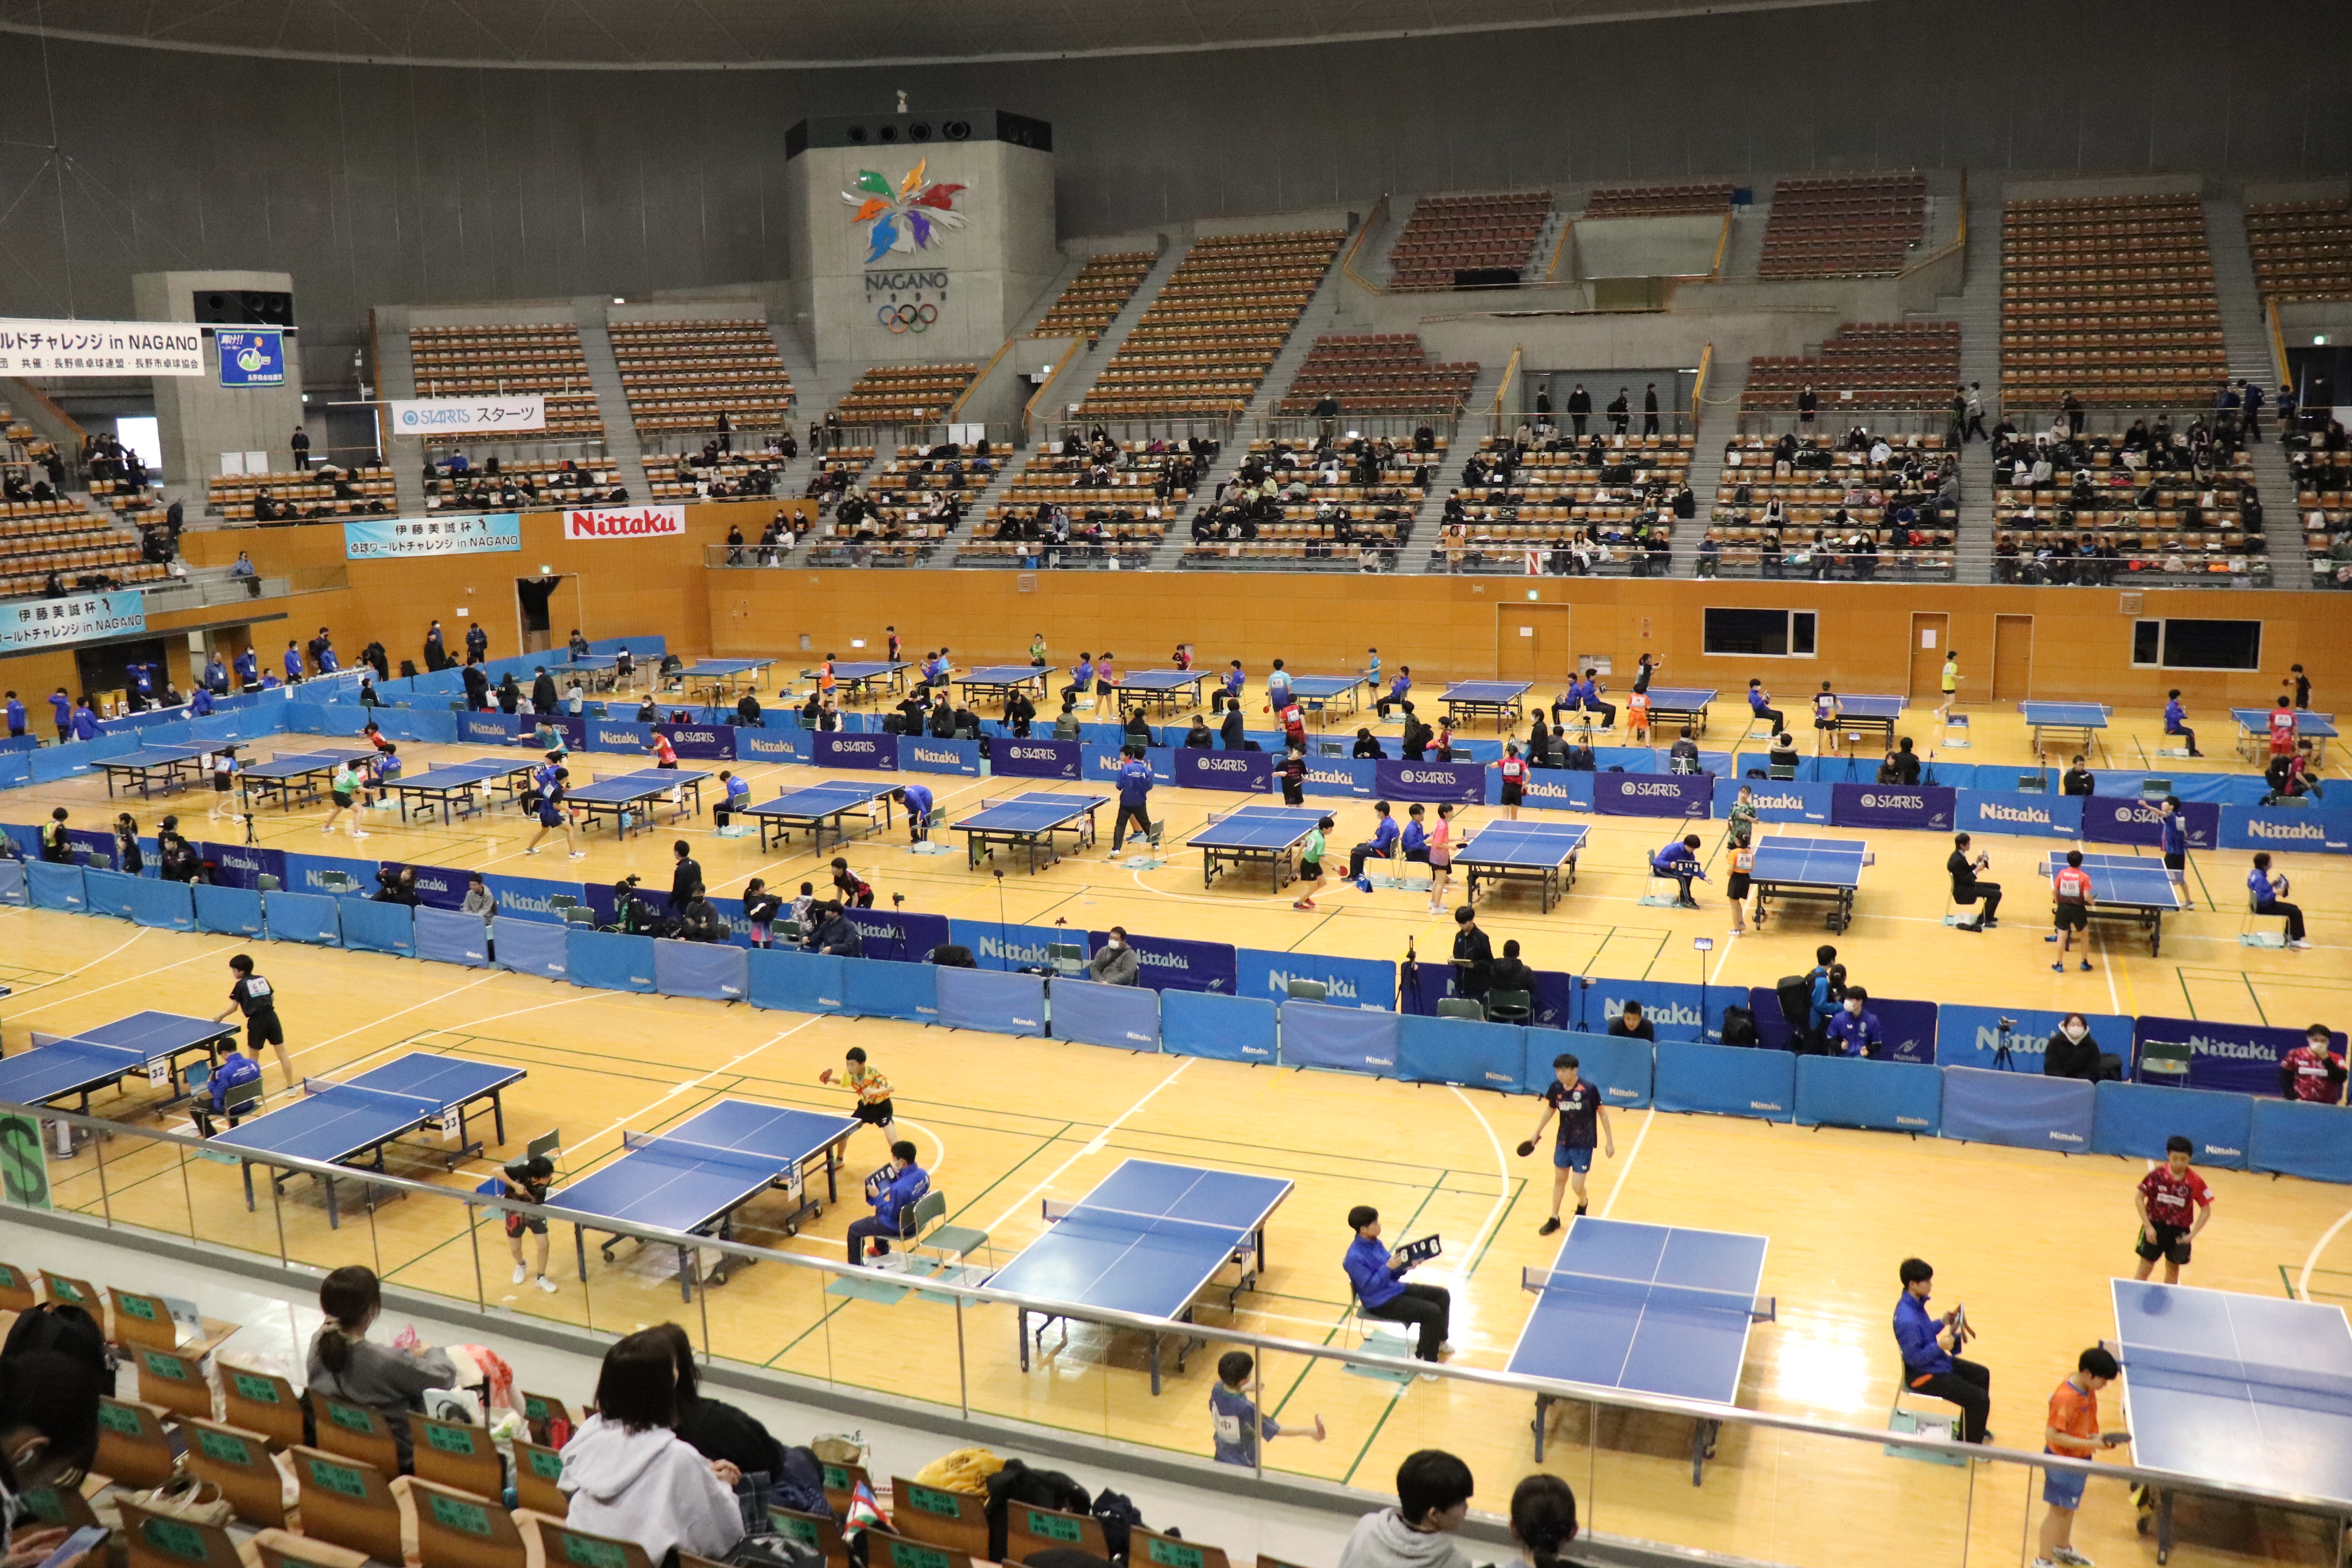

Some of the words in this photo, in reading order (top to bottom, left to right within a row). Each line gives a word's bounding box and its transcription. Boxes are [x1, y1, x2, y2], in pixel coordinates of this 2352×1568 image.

[865, 272, 948, 291] NAGANO
[109, 334, 123, 349] in
[129, 334, 198, 351] NAGANO
[420, 409, 471, 425] STARTS
[477, 407, 534, 423] スターツ
[396, 521, 472, 536] 伊藤美誠杯
[572, 509, 677, 537] Nittaku
[351, 538, 453, 554] 卓球ワールドチャレンジ
[457, 538, 466, 548] in
[470, 535, 518, 547] NAGANO
[1525, 552, 1542, 575] N
[19, 601, 96, 623] 伊藤美誠杯
[0, 622, 80, 643] ールドチャレンジ
[83, 623, 93, 633] in
[96, 615, 142, 631] NAGANO
[469, 721, 506, 736] Nittaku
[599, 730, 641, 745] Nittaku
[750, 738, 795, 754] Nittaku
[914, 747, 961, 765] Nittaku
[1752, 793, 1804, 809] ittaku
[1979, 802, 2051, 824] Nittaku
[2248, 819, 2325, 839] Nittaku
[223, 854, 259, 871] Nittaku
[1242, 1045, 1269, 1055] Nittaku
[2189, 1034, 2278, 1061] Nittaku
[1366, 1056, 1394, 1066] Nittaku
[152, 1066, 165, 1079] 32
[444, 1116, 457, 1131] 33
[0, 1117, 48, 1204] S
[887, 1166, 895, 1180] 0
[789, 1174, 800, 1190] 34
[1400, 1248, 1409, 1263] 6
[1412, 1244, 1418, 1253] 1
[1420, 1241, 1425, 1250] 0
[1429, 1239, 1439, 1255] 6
